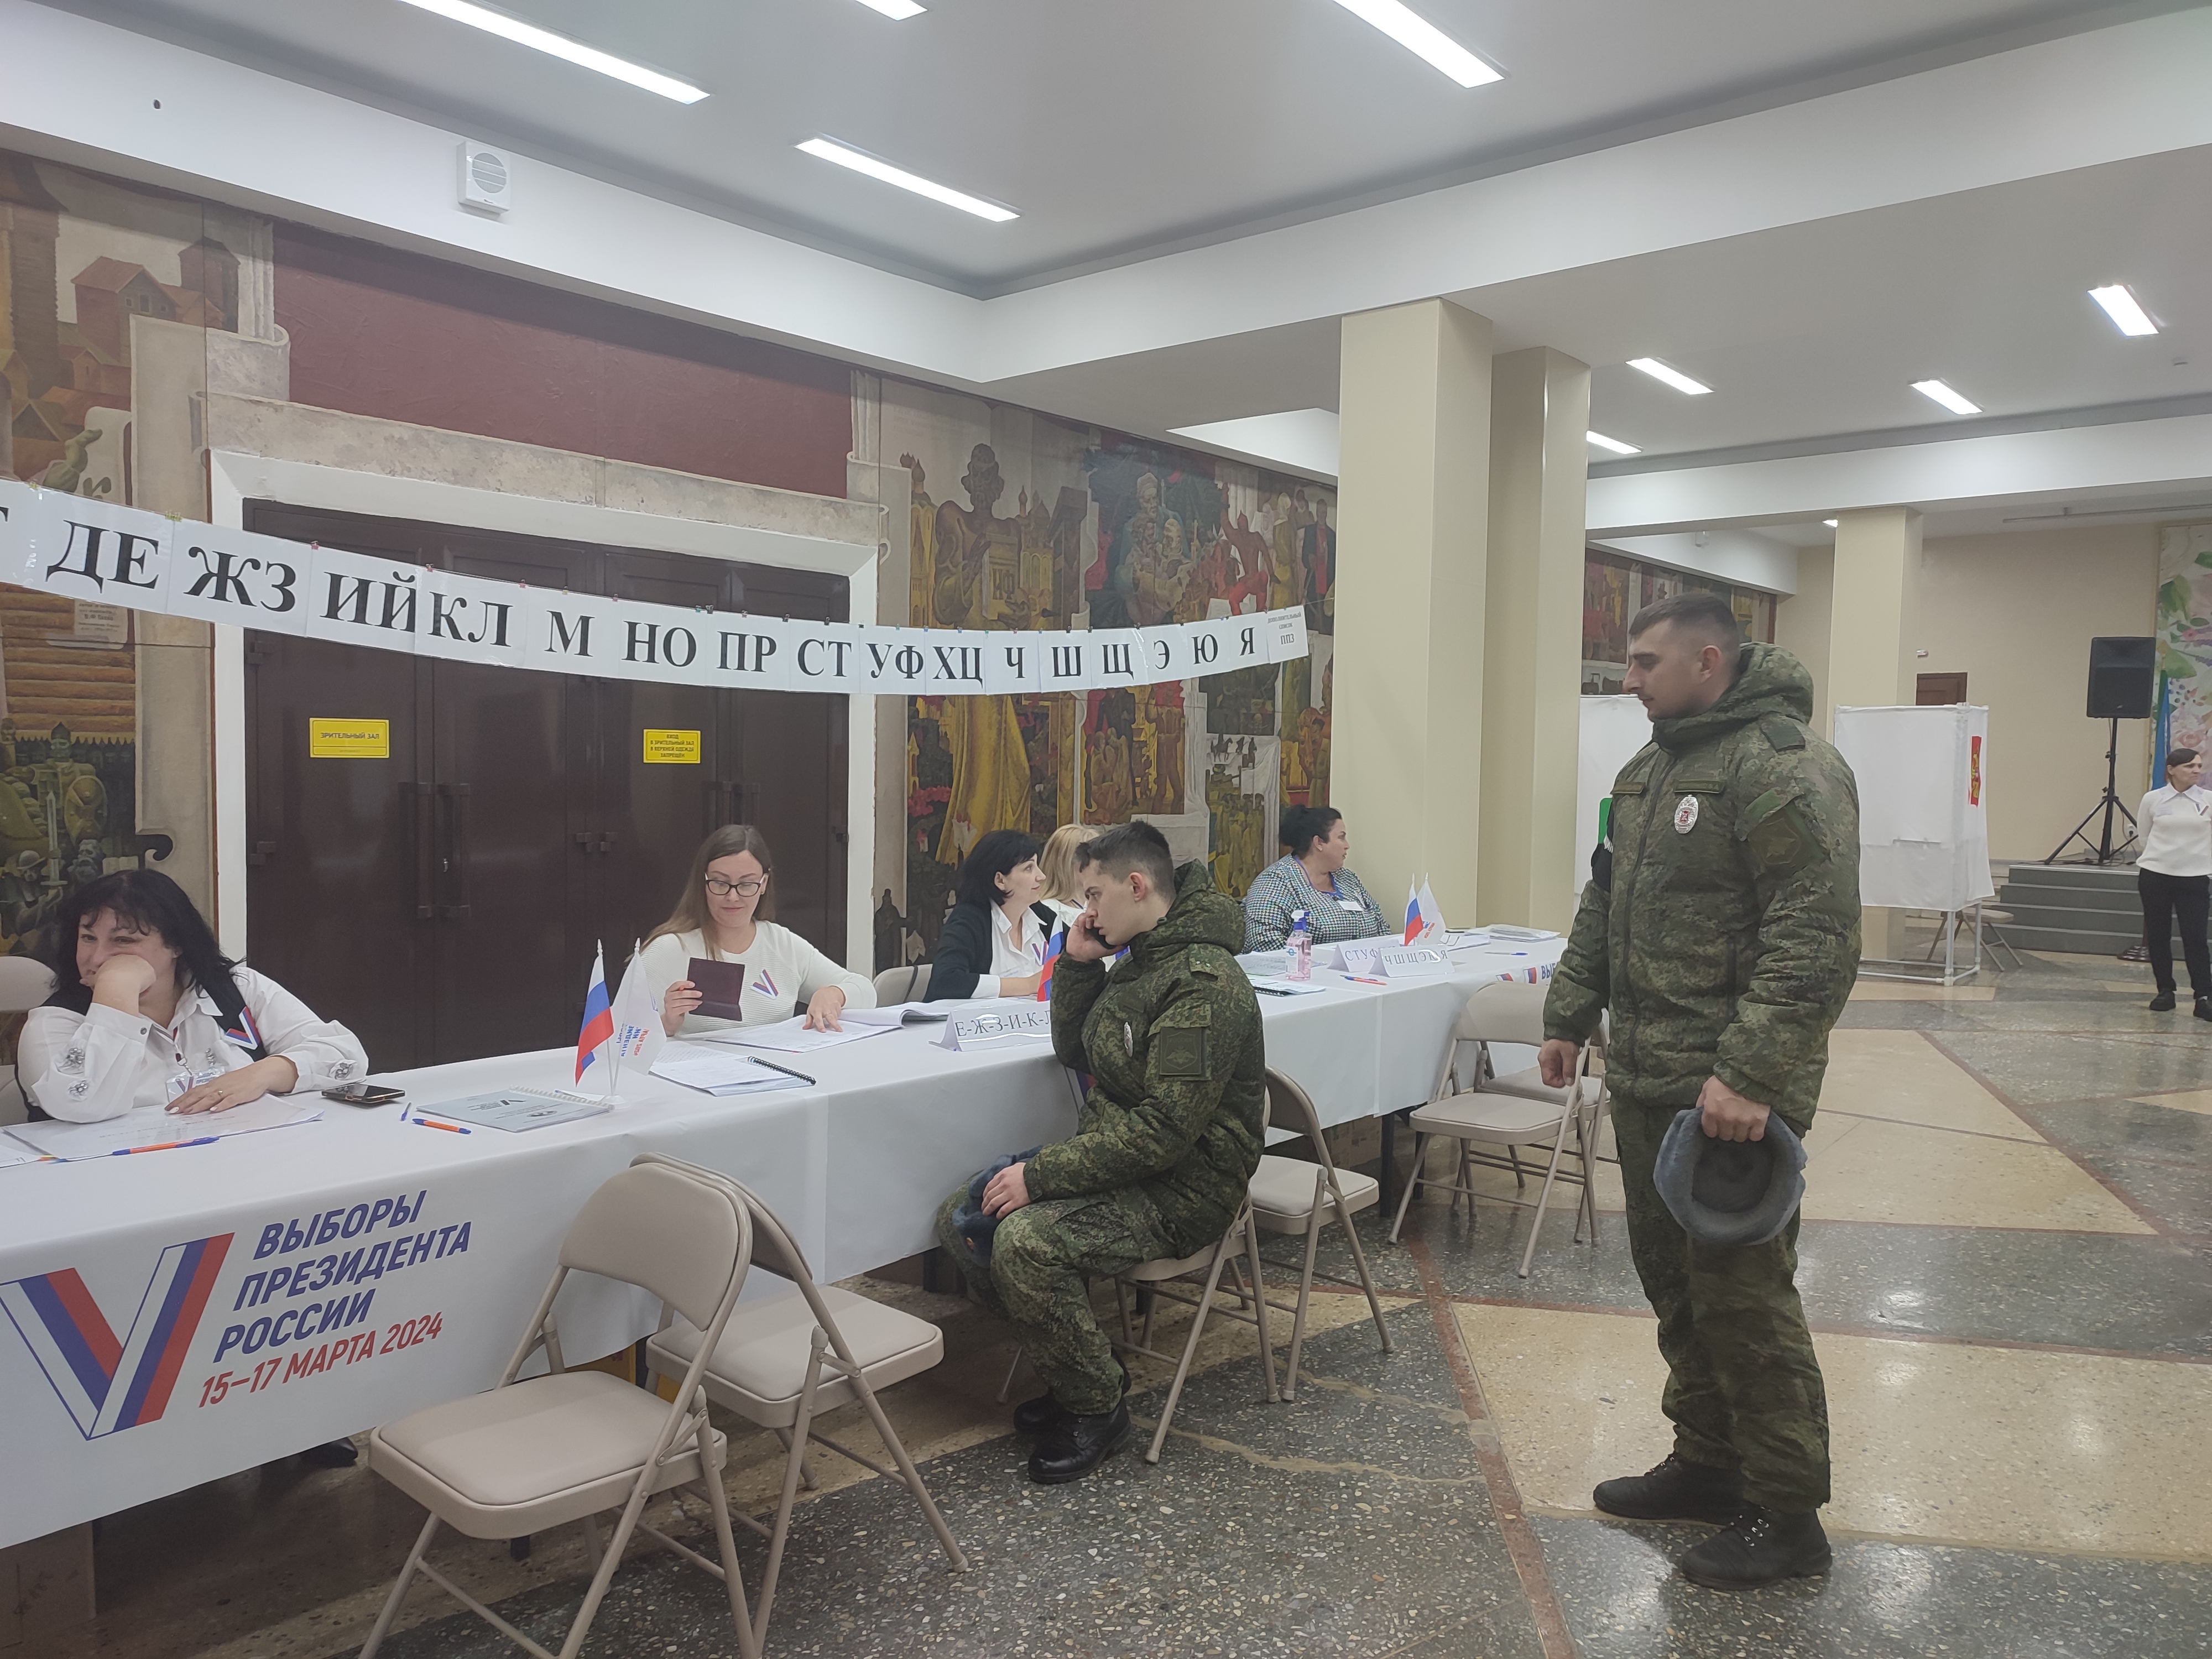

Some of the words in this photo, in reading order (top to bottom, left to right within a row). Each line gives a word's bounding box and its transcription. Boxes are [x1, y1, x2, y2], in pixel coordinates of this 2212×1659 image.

[46, 520, 159, 593] ДЕ
[183, 546, 296, 612] ЖЗ
[544, 610, 594, 657] М
[622, 620, 697, 667] НО
[716, 630, 777, 673] ПР
[797, 639, 852, 677] СТ
[1004, 647, 1026, 679] Ч
[1051, 645, 1082, 678] Ш
[1102, 644, 1134, 681] Щ
[1154, 640, 1170, 670] Э
[1192, 634, 1218, 665] Ю
[1240, 627, 1255, 656] Я
[253, 1190, 427, 1260] ВЫБОРЫ
[233, 1221, 472, 1311] ПРЕЗИДЕНТА
[213, 1289, 375, 1363] РОССИИ
[283, 1331, 376, 1384] МАРТА
[379, 1312, 443, 1355] 2024
